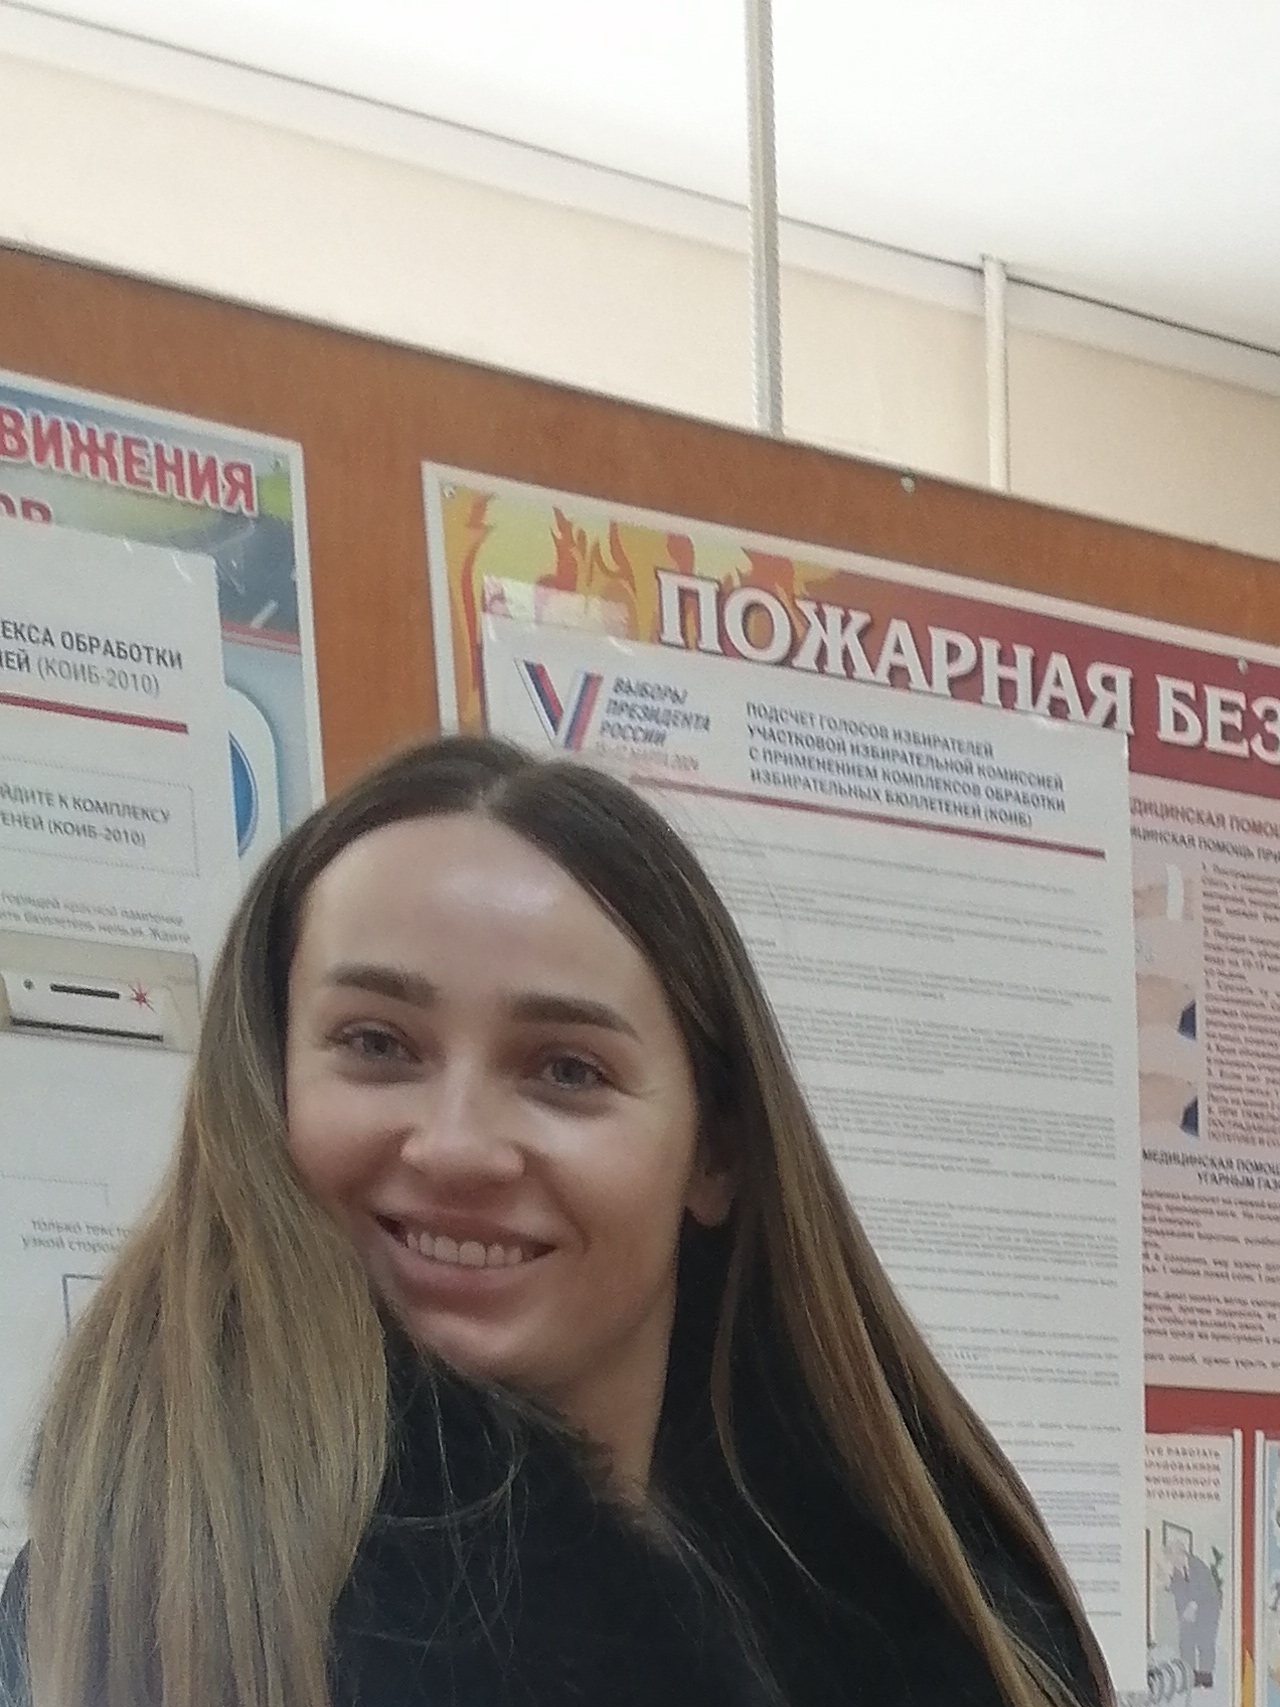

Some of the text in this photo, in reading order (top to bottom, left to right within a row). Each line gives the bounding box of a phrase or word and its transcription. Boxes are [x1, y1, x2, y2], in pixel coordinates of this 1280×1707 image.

[0, 405, 257, 516] ВИЖЕНИЯ
[61, 630, 183, 670] ОБРАБОТКИ
[656, 567, 1133, 736] ПОЖАРНАЯ
[37, 657, 160, 698] (КОИБ-2010)
[613, 676, 689, 705] ВЫБОРЫ
[600, 719, 667, 747] РОССИИ
[606, 698, 711, 732] ПРЕЗИДЕНТА
[819, 714, 889, 740] ГОЛОСОВ
[893, 727, 994, 759] ИЗБИРАТЕЛЕЙ
[748, 724, 1064, 792] УЧАСТКОВОЙ ИЗБИРАТЕЛЬНОЙ КОМИССИЕЙ
[751, 768, 1032, 828] ИЗБИРАТЕЛЬНЫХ БЮЛЛЕТЕНЕЙ (КОИБ)
[763, 750, 878, 780] ПРИМЕНЕНИЕМ
[882, 767, 981, 797] КОМПЛЕКСОВ
[984, 784, 1066, 813] ОБРАБОТКИ
[58, 794, 70, 810] К
[72, 796, 171, 824] КОМПЛЕКСУ
[48, 819, 146, 848] (КОИБ-2010)
[1199, 838, 1254, 859] ПОМОЩЬ
[1257, 846, 1280, 863] ПРИ
[1142, 1148, 1234, 1171] МЕДИЦИНСКАЯ
[1198, 1173, 1255, 1189] УГАРНЫМ
